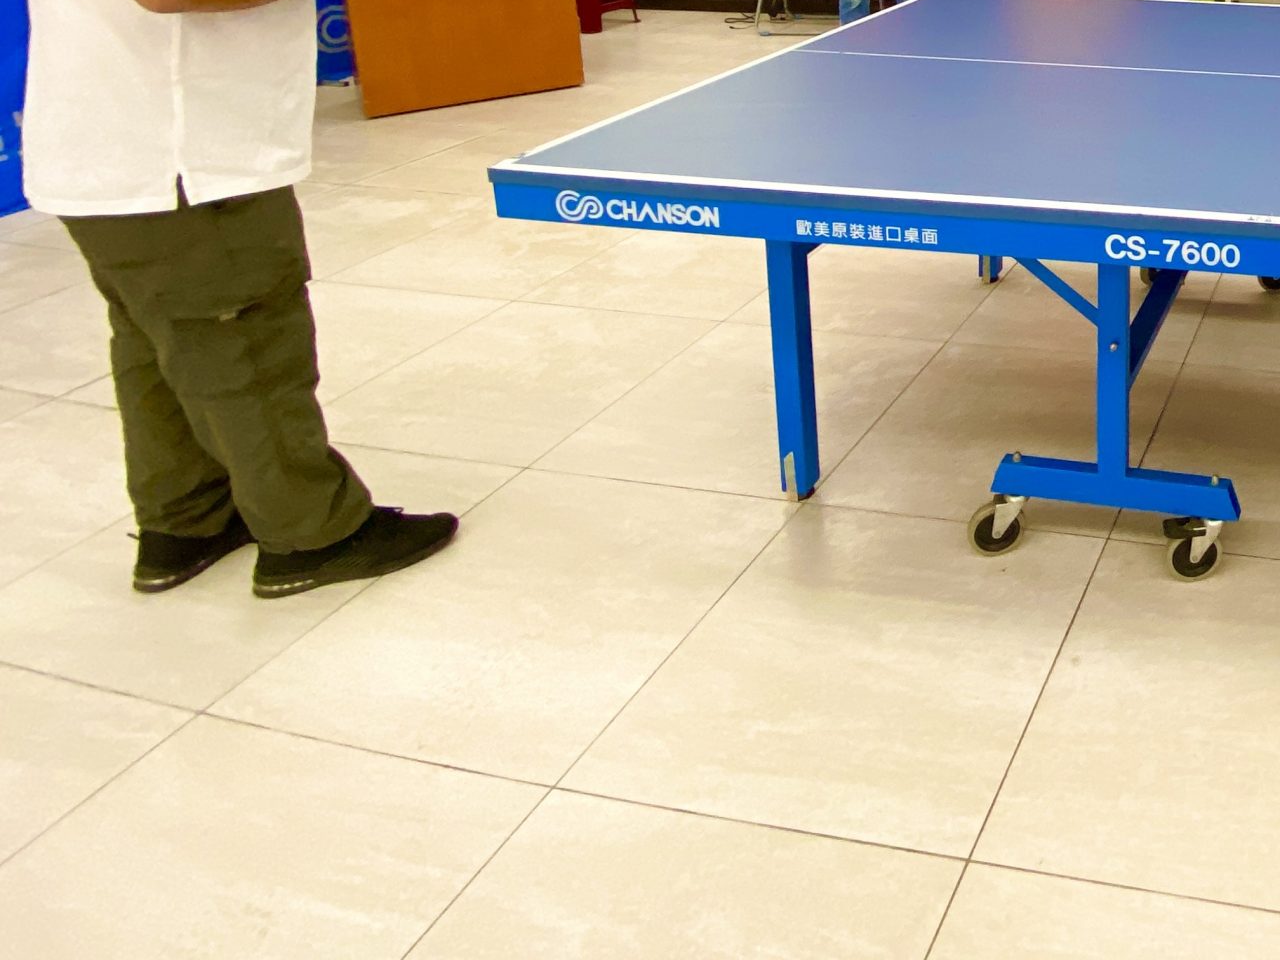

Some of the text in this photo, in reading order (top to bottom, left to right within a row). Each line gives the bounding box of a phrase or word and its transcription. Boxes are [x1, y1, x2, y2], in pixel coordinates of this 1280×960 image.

[606, 198, 720, 228] CHANSON
[795, 219, 938, 245] 歐美原裝進口桌面
[1104, 234, 1241, 268] CS-7600
